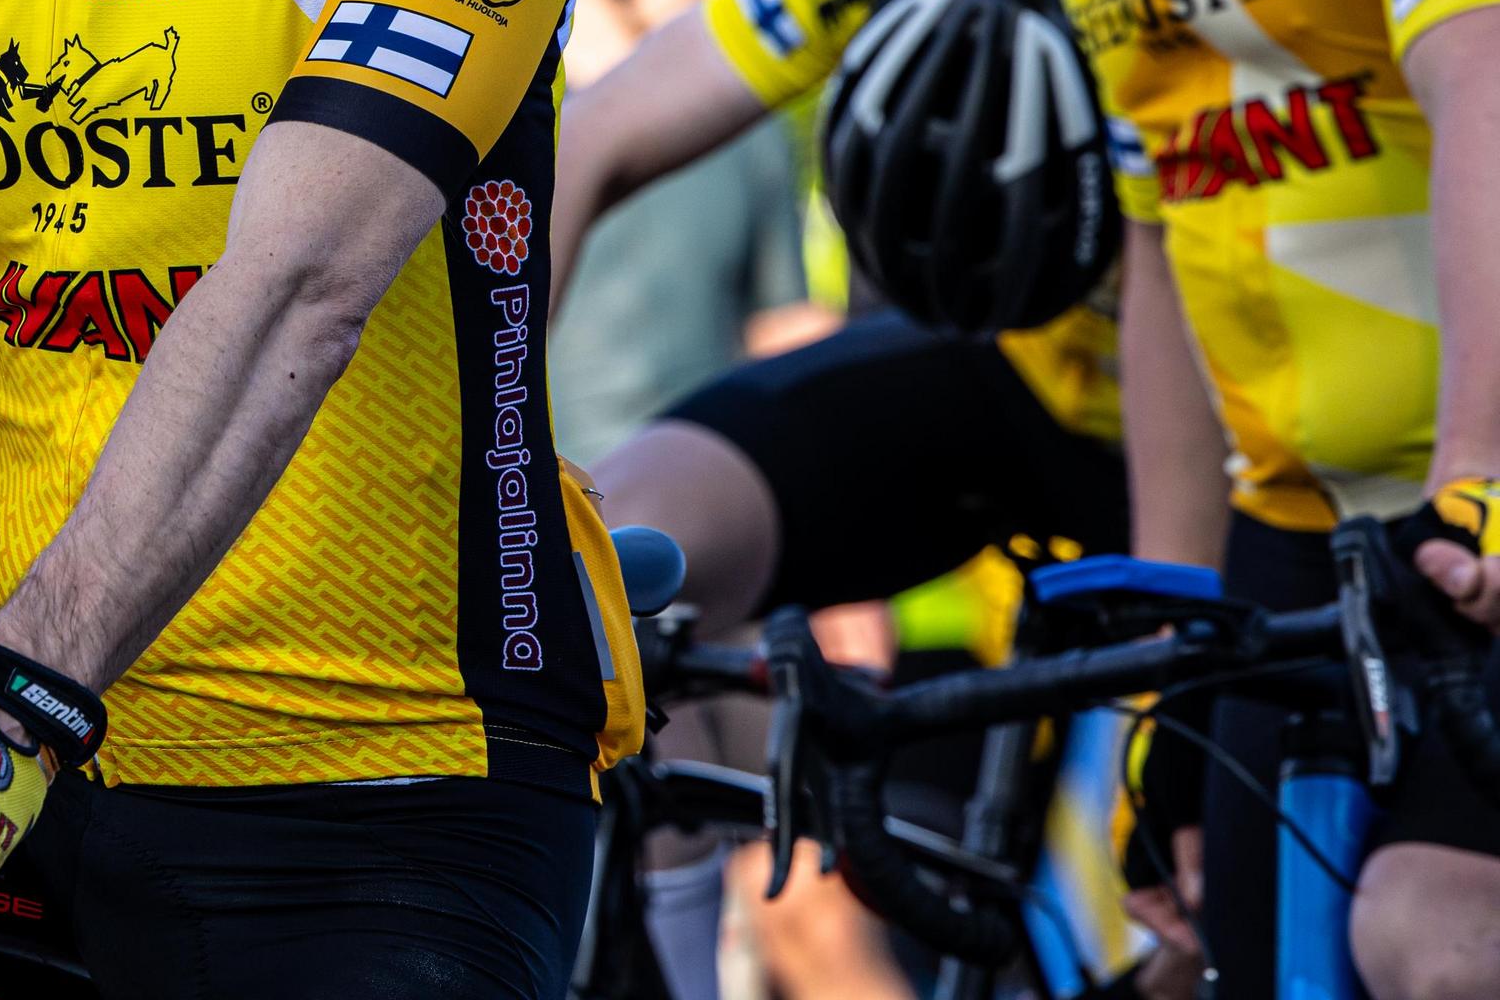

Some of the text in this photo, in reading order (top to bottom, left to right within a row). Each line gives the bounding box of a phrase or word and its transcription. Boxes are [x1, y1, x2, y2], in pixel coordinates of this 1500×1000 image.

[466, 0, 509, 27] HUOLTOJA
[486, 284, 543, 671] Pihlajalinna
[20, 683, 93, 738] Santini
